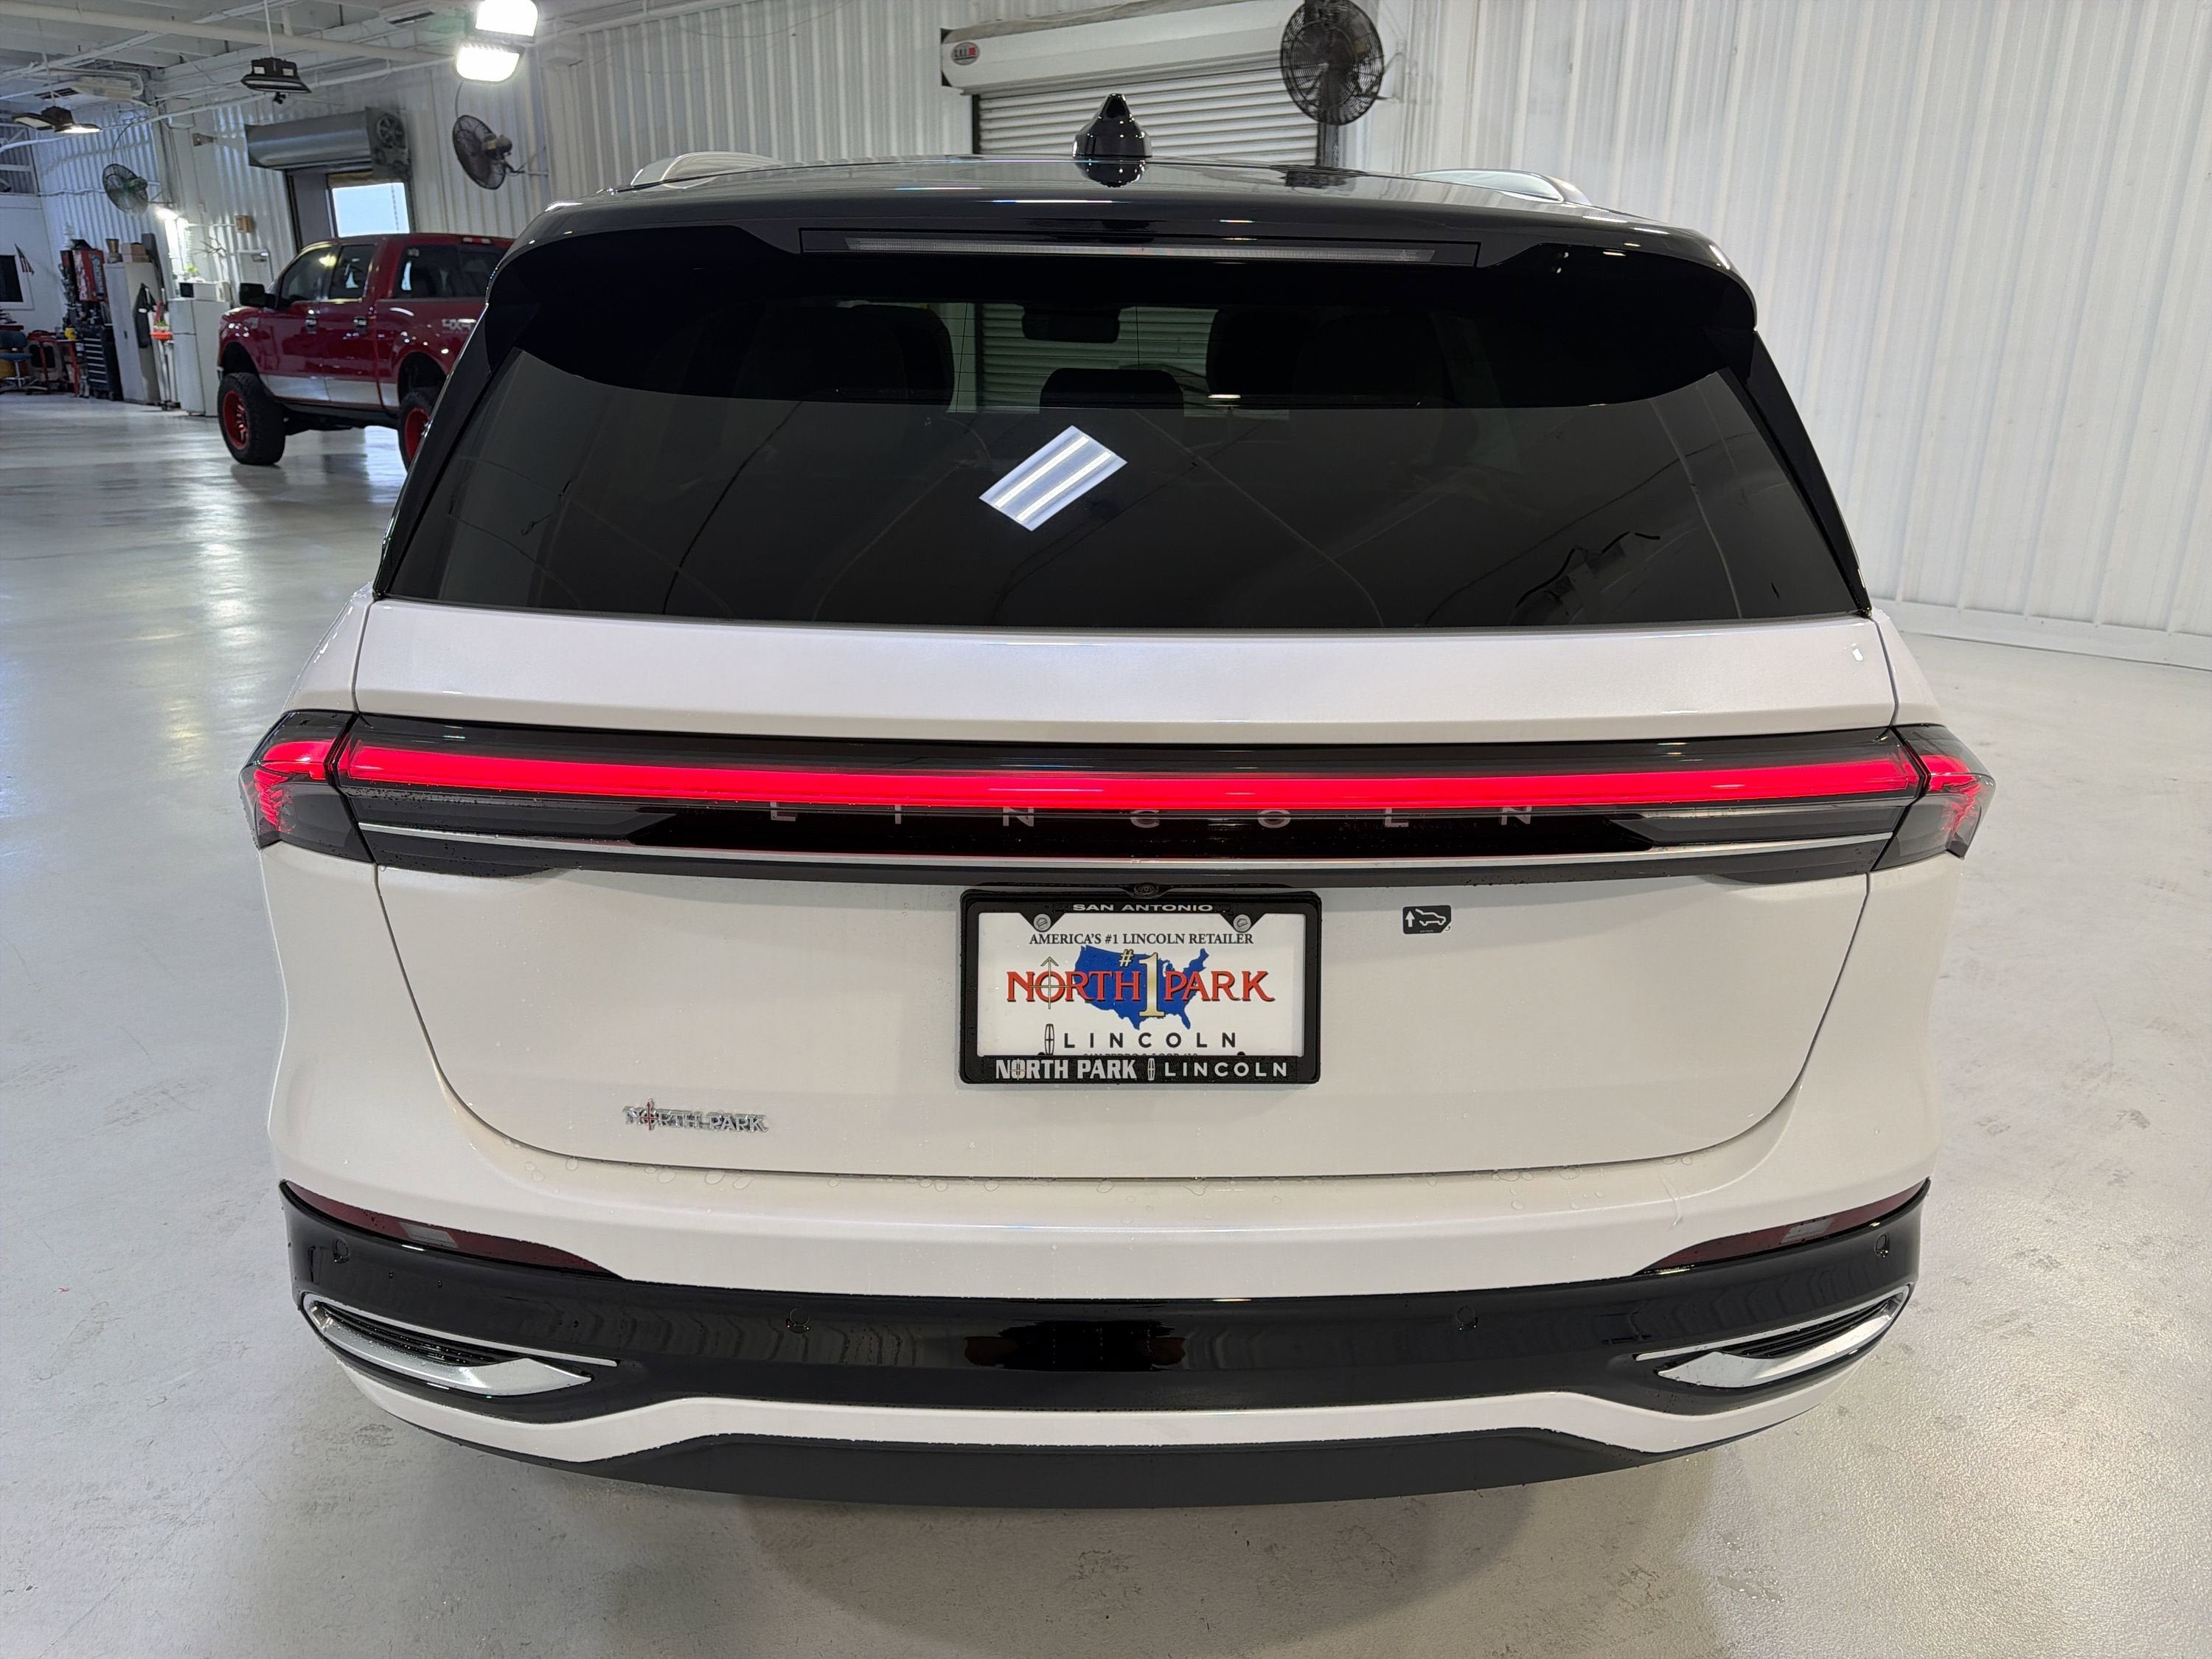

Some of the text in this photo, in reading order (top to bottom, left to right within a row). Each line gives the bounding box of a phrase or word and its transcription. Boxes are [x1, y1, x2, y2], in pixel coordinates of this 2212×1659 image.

[770, 801, 1533, 829] LINCOLN
[1029, 933, 1254, 945] AMERICA'S #1 LINCOLN RETAILER
[1006, 970, 1276, 1003] NORTH PARK
[1064, 1032, 1236, 1049] LINCOLN
[995, 1059, 1287, 1079] NORTH PARK LINCOLN
[624, 1104, 769, 1133] NORTH PARK
